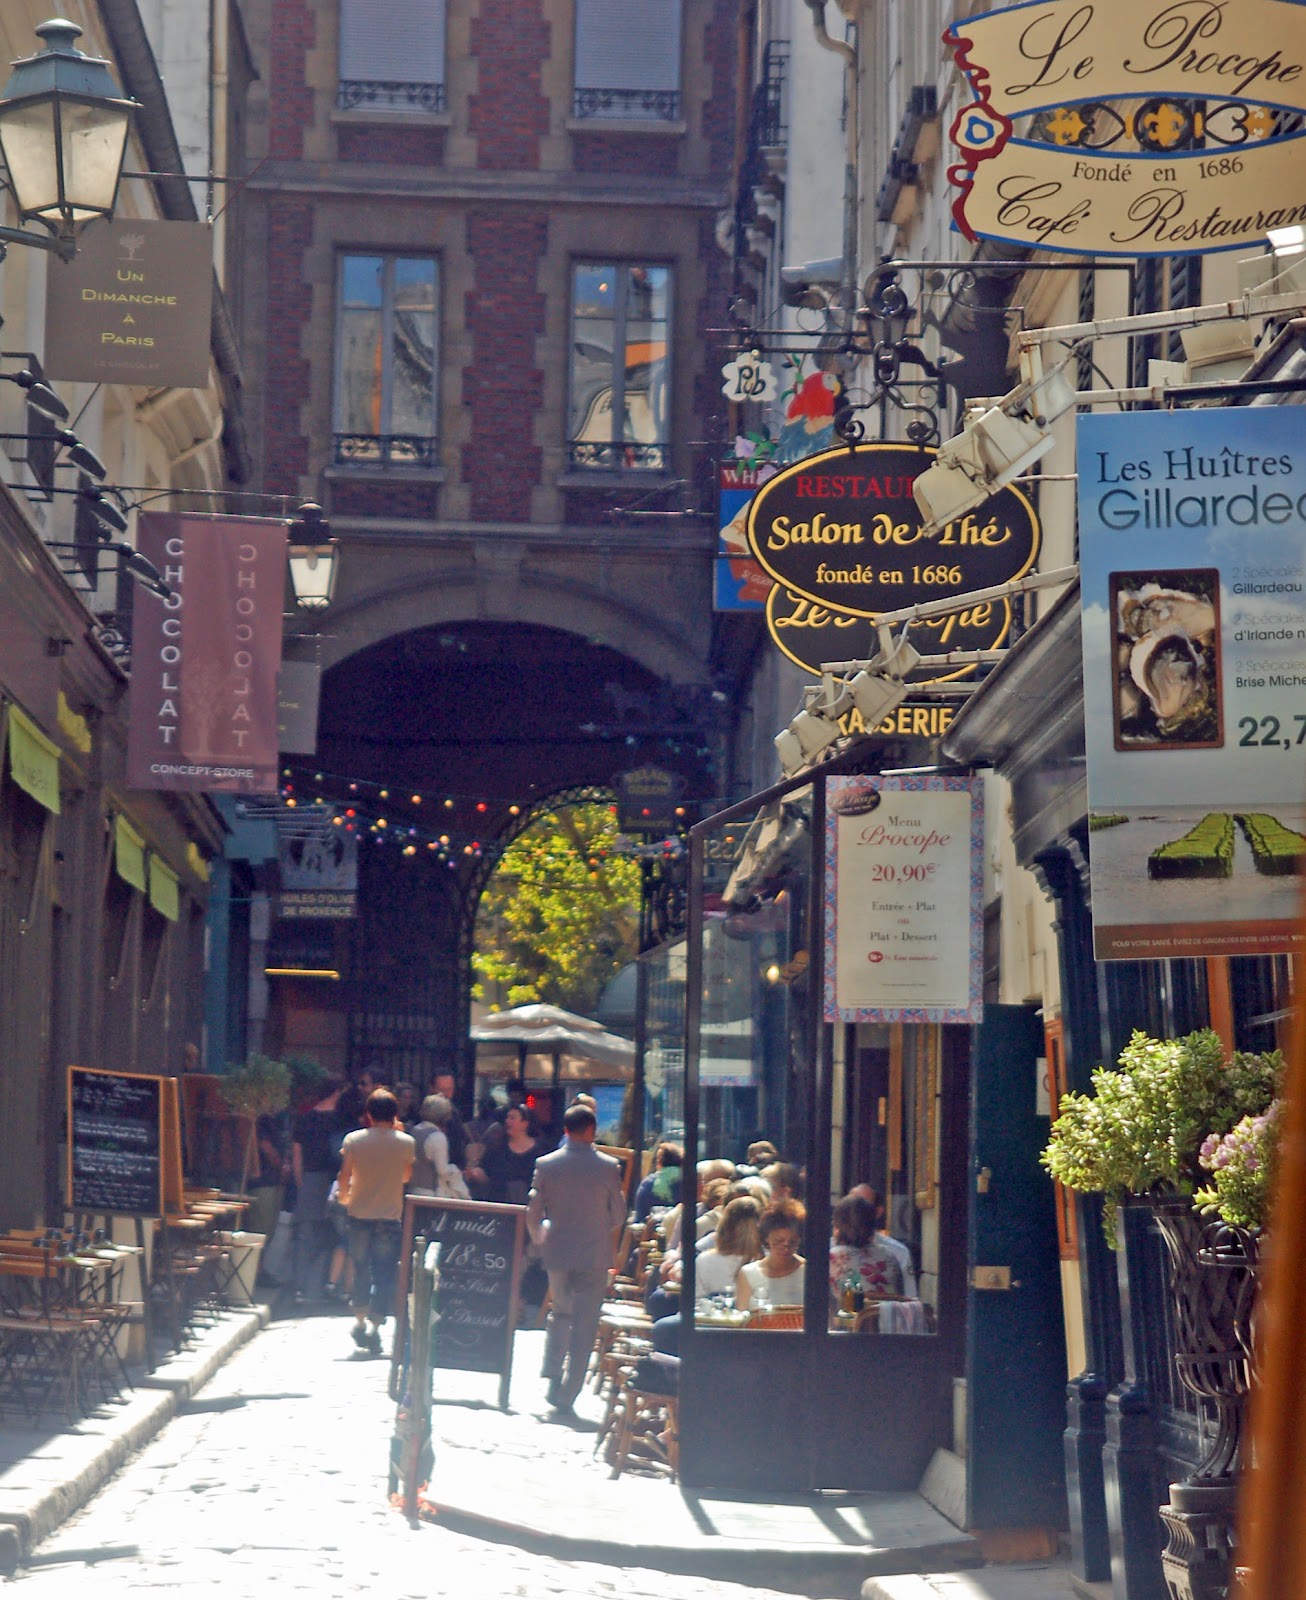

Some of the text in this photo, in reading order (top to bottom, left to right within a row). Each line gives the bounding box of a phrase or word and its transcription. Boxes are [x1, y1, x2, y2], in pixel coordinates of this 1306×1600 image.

[1004, 1, 1303, 95] Le Procope
[1072, 156, 1243, 182] Fondé en 1686
[996, 175, 1091, 242] Café
[734, 364, 766, 396] Pub
[1097, 446, 1293, 483] Les Huîtres
[767, 513, 863, 550] Salon
[873, 514, 922, 545] de
[938, 514, 1011, 546] Thé
[816, 563, 962, 584] fondé en 1686
[1233, 582, 1302, 594] Gillardeau
[158, 538, 184, 743] CHOCOLAT
[1234, 629, 1294, 641] d'Irlande
[1235, 661, 1243, 672] 2
[1236, 677, 1265, 688] Brise
[151, 764, 254, 779] CONCEPT-STORE
[888, 816, 921, 827] Menu
[856, 825, 951, 854] Procope
[872, 901, 905, 911] Entrée
[916, 901, 936, 911] Plat
[870, 931, 890, 941] Plat
[901, 931, 937, 941] Dessert
[454, 1216, 499, 1236] midi
